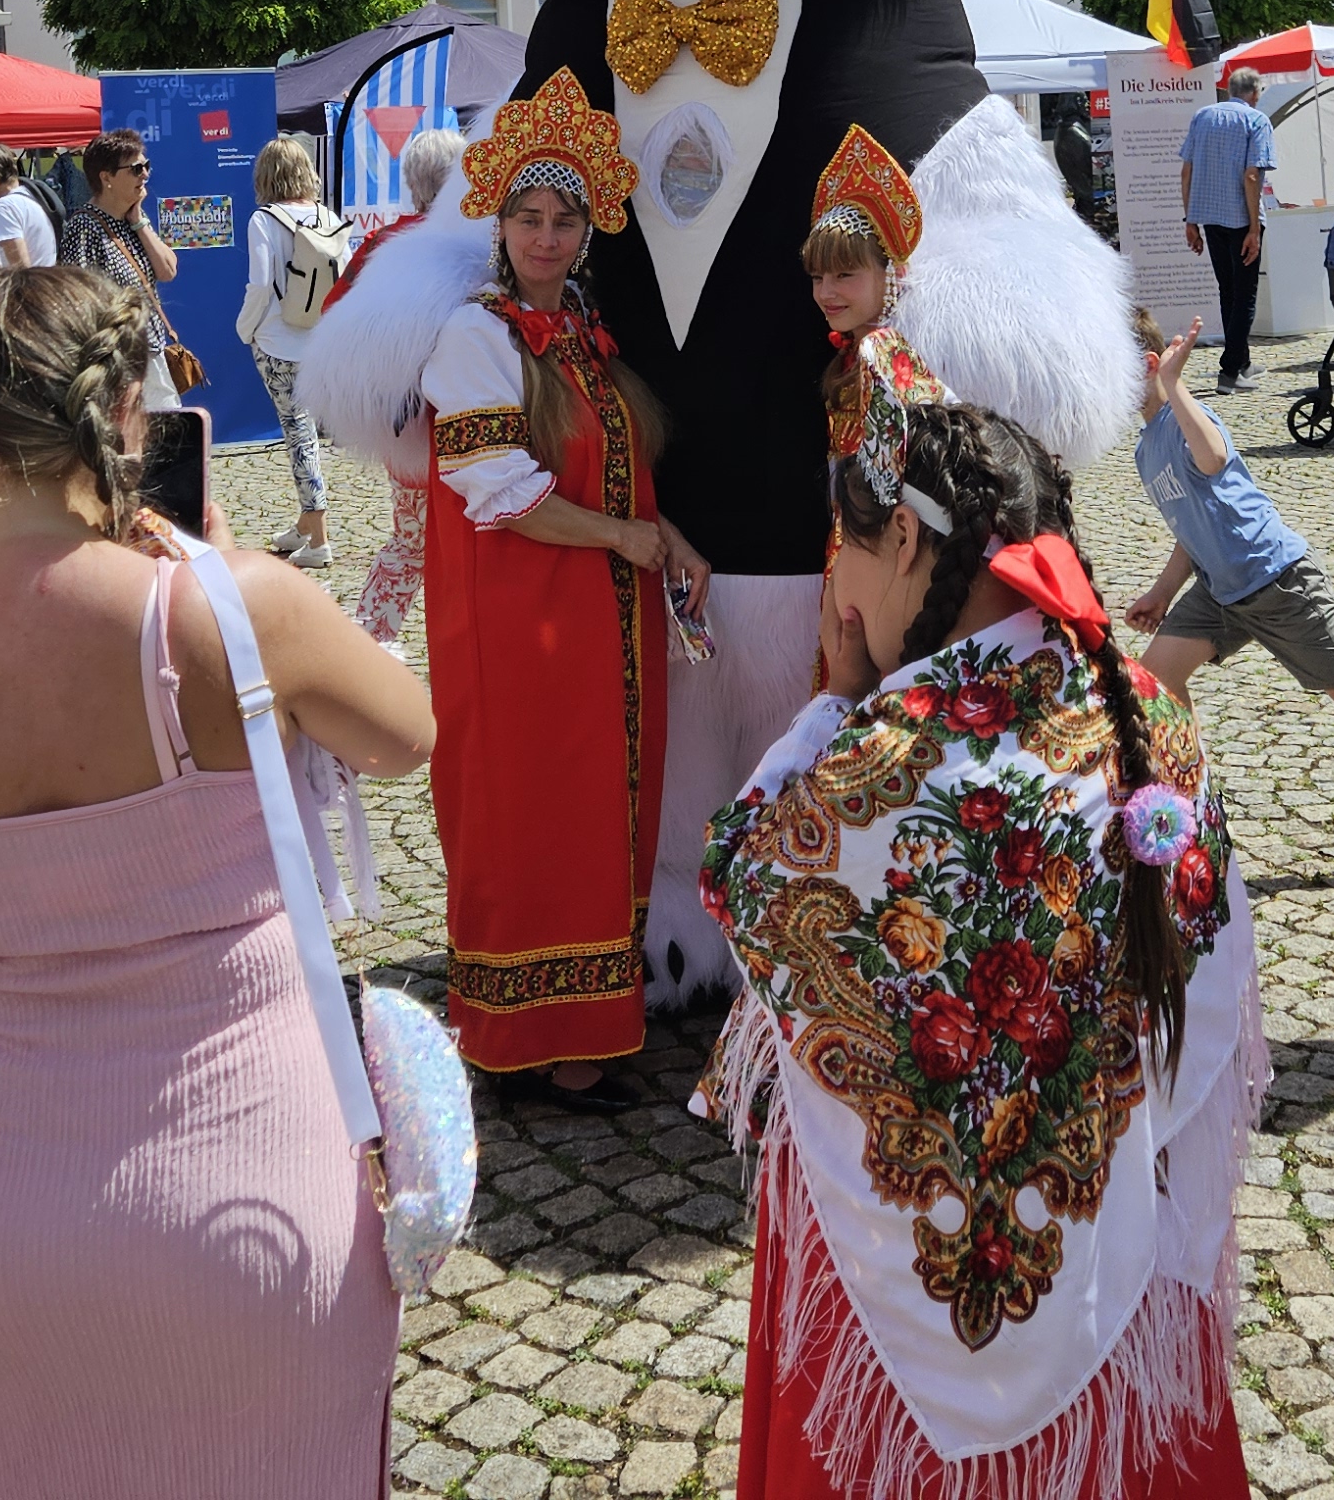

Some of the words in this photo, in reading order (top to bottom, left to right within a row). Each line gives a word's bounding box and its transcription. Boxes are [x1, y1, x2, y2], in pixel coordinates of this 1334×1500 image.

[1121, 78, 1145, 93] Die
[1148, 77, 1203, 92] Jesiden
[161, 209, 227, 225] #buntstadt
